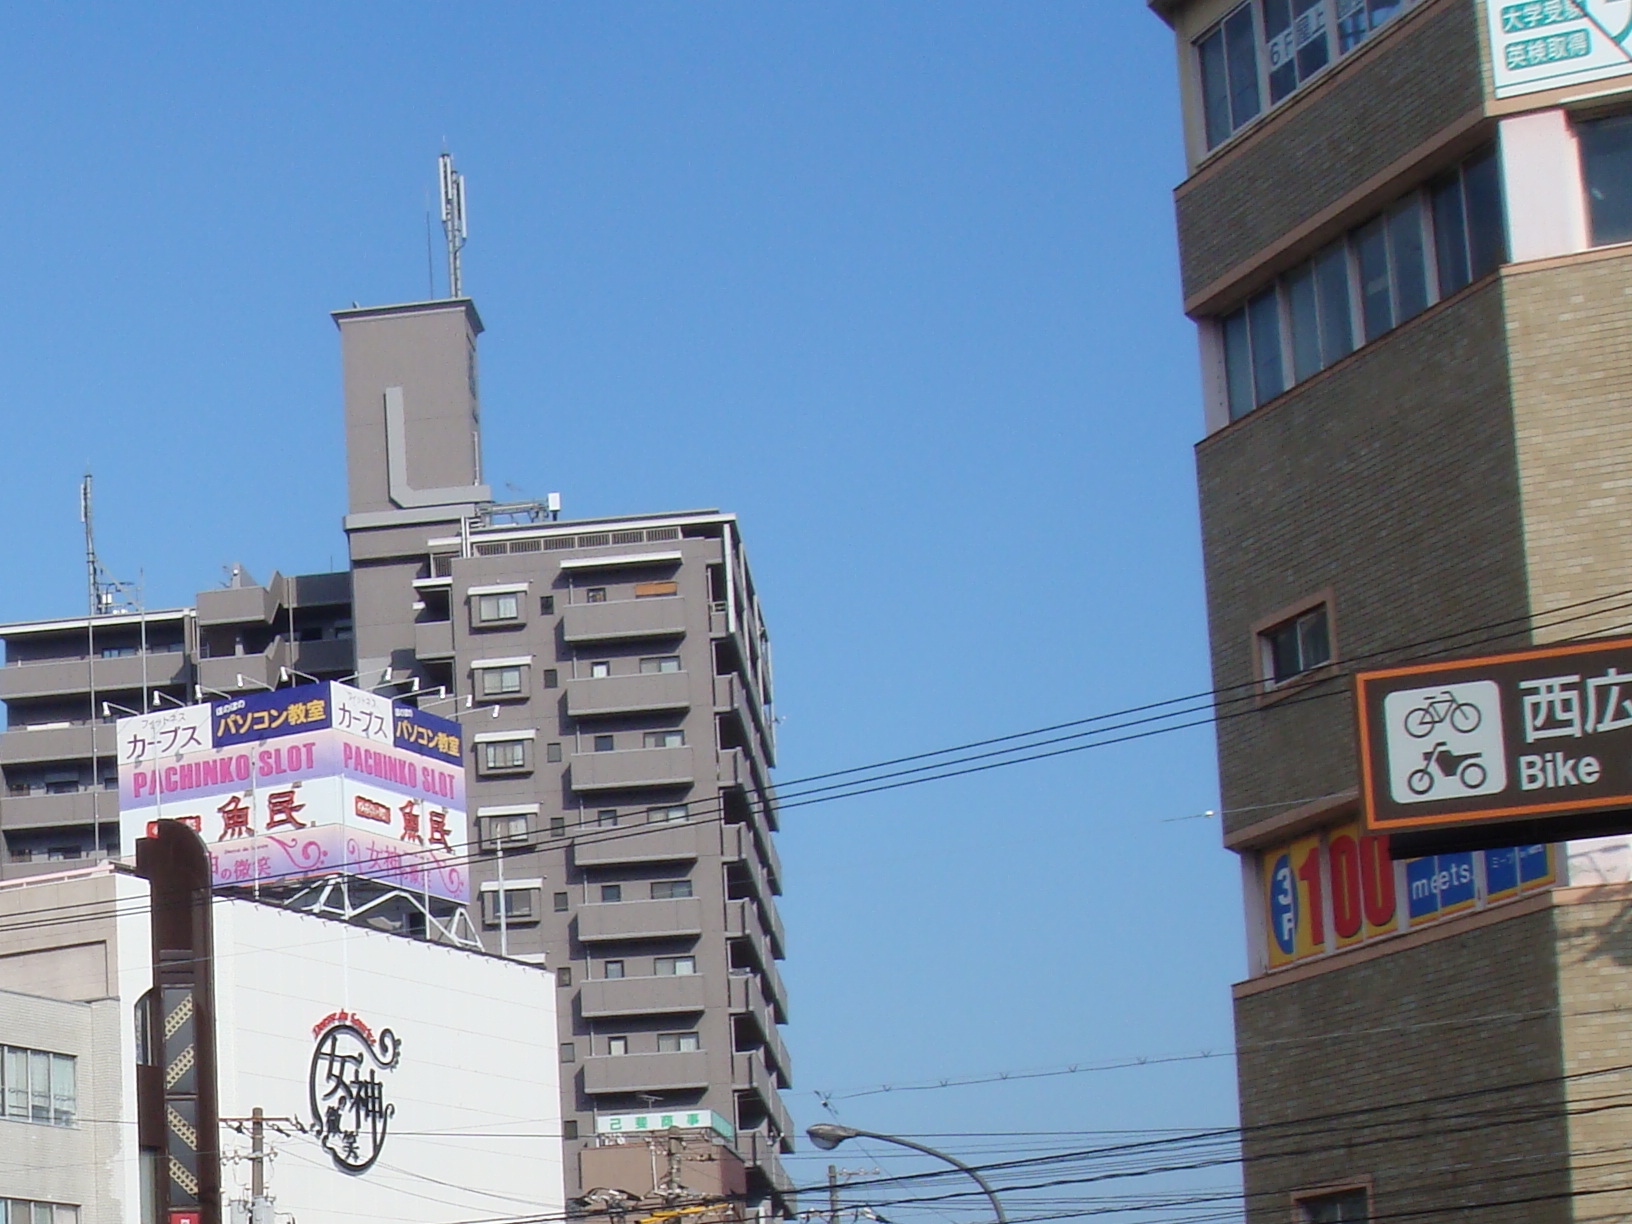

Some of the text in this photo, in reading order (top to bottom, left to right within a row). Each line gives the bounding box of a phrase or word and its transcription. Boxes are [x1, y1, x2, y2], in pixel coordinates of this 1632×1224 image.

[1506, 30, 1588, 70] 英検取得
[216, 699, 327, 738] パソコン教室
[338, 701, 389, 739] カーブス
[395, 719, 461, 758] パソコン教室
[126, 725, 203, 760] カーブス
[133, 742, 317, 799] PACHINKO SLOT
[342, 741, 457, 801] PACHINKO SLOT
[1518, 750, 1601, 792] Bike
[216, 789, 308, 842] 魚民
[398, 797, 456, 857] 魚民
[1297, 832, 1396, 947] 100
